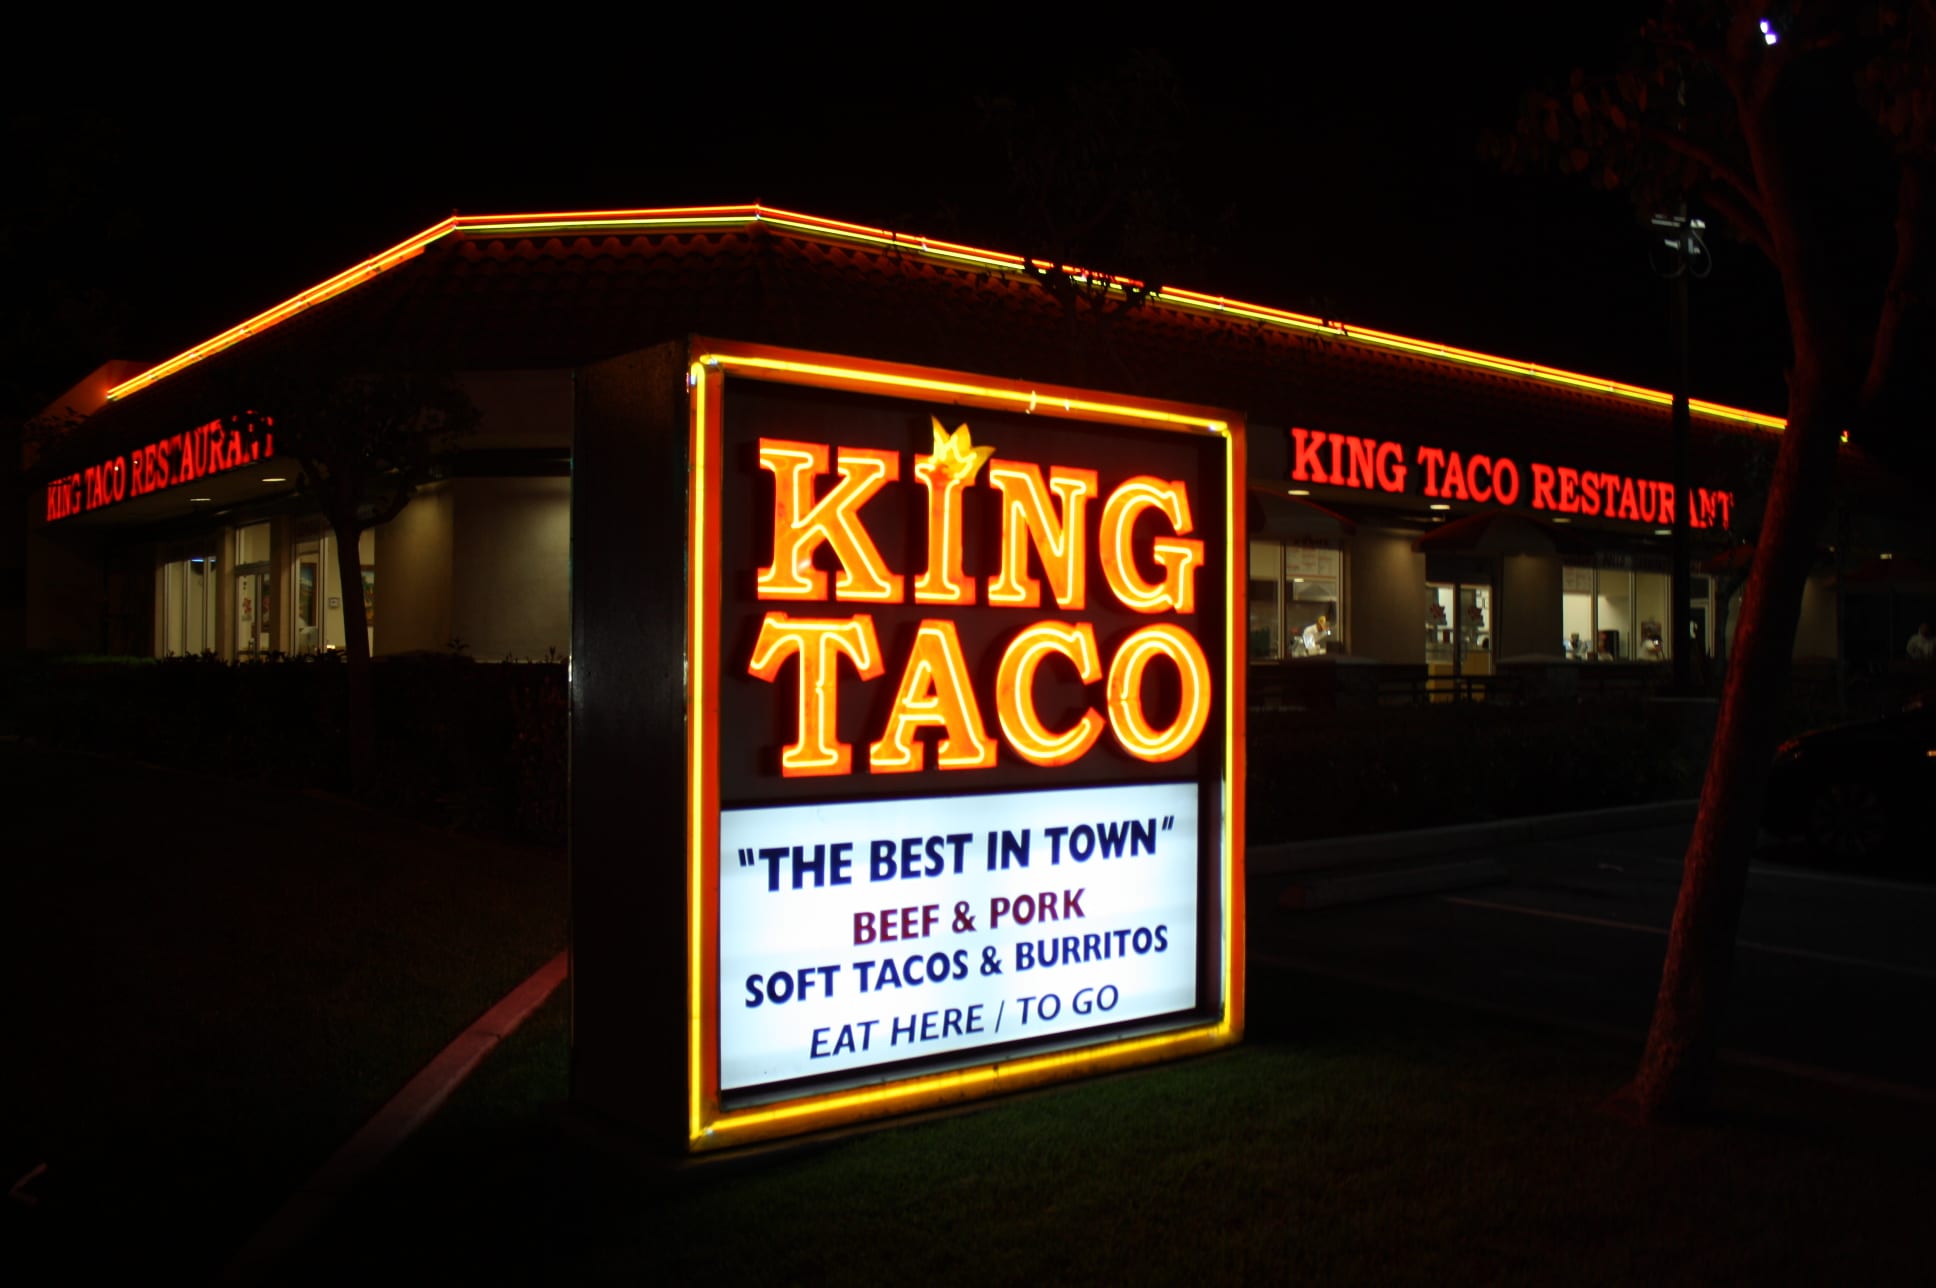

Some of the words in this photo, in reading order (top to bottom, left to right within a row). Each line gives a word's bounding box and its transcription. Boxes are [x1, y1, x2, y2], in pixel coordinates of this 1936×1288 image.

[47, 472, 82, 521] KING
[85, 455, 126, 510] TACO
[1291, 428, 1407, 492] KING
[1417, 446, 1519, 506] TACO
[757, 436, 1204, 614] KING
[748, 611, 1211, 778] TACO
[738, 842, 853, 892] "THE
[870, 833, 973, 881] BEST
[987, 828, 1031, 871] IN
[1045, 815, 1175, 865] TOWN"
[853, 904, 940, 946] BEEF
[951, 901, 976, 933] &
[990, 888, 1085, 929] PORK
[745, 964, 841, 1008] SOFT
[853, 949, 969, 993] TACOS
[979, 946, 1002, 976] &
[1015, 925, 1168, 972] BURRITOS
[809, 1020, 879, 1059] EAT
[891, 1003, 984, 1046] HERE
[1017, 993, 1060, 1025] TO
[1072, 984, 1119, 1015] GO
